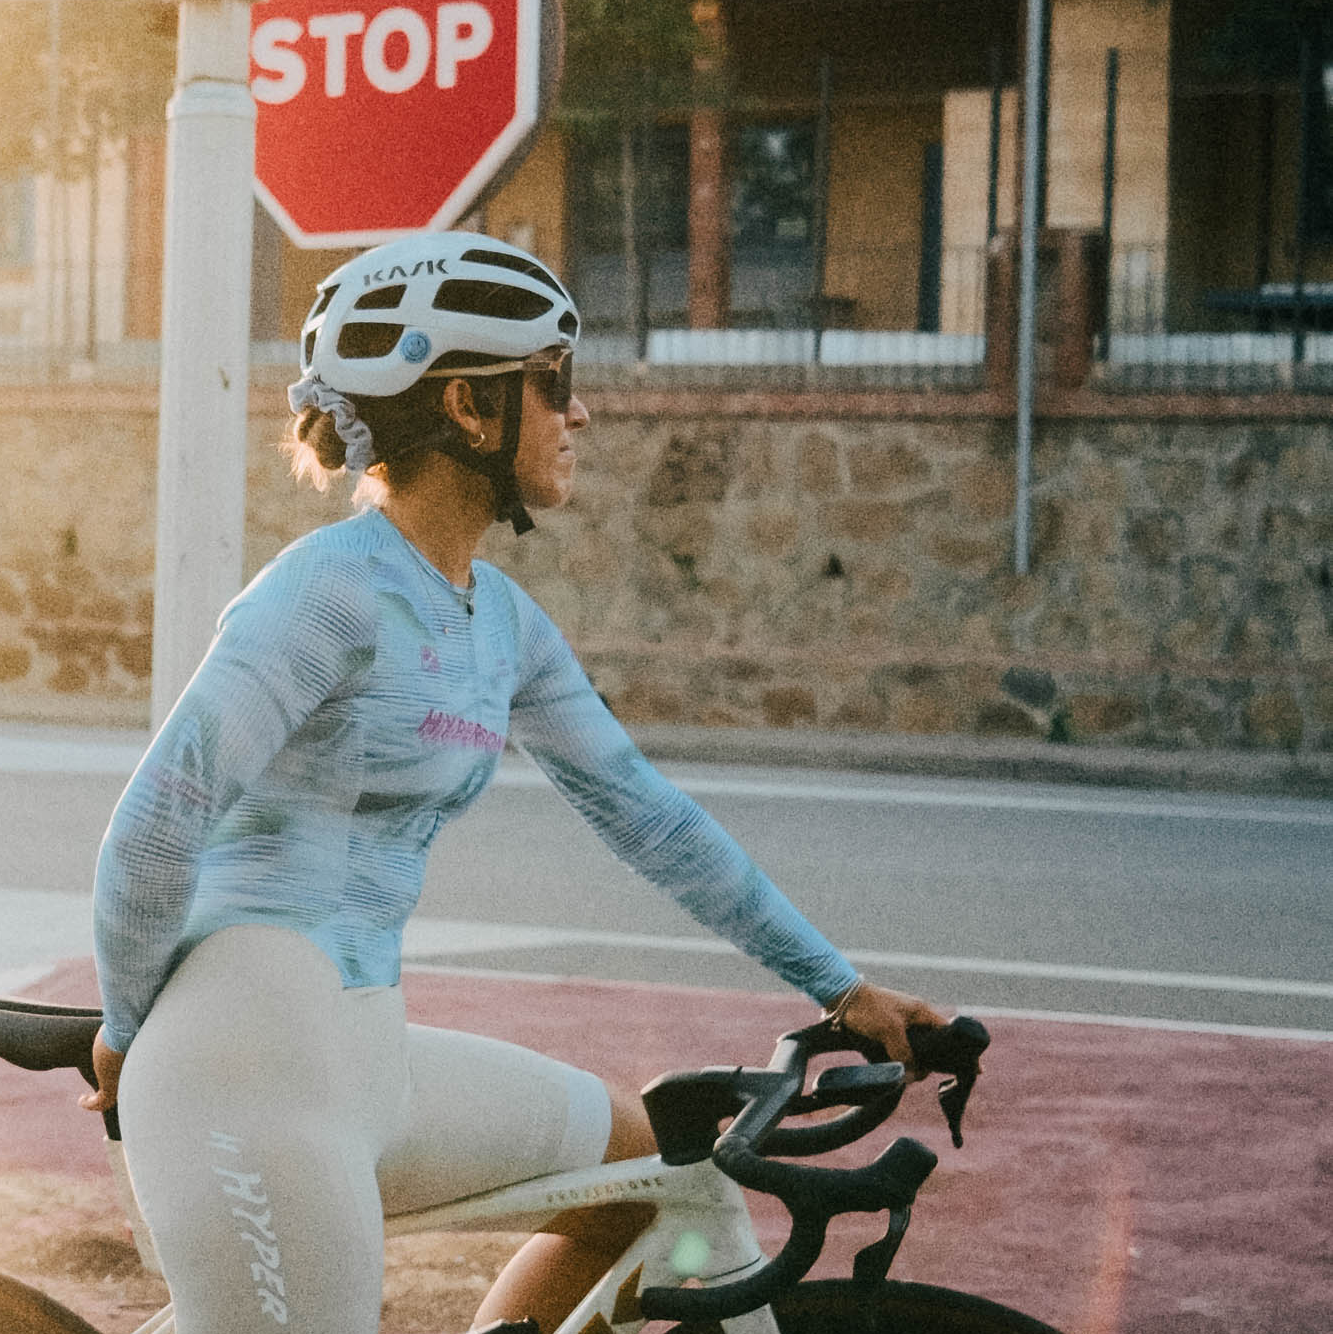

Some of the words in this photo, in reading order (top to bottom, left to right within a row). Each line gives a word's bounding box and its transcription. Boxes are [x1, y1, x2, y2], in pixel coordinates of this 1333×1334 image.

[250, 0, 494, 105] STOP
[362, 258, 450, 287] KASK
[211, 1165, 288, 1325] HYPER
